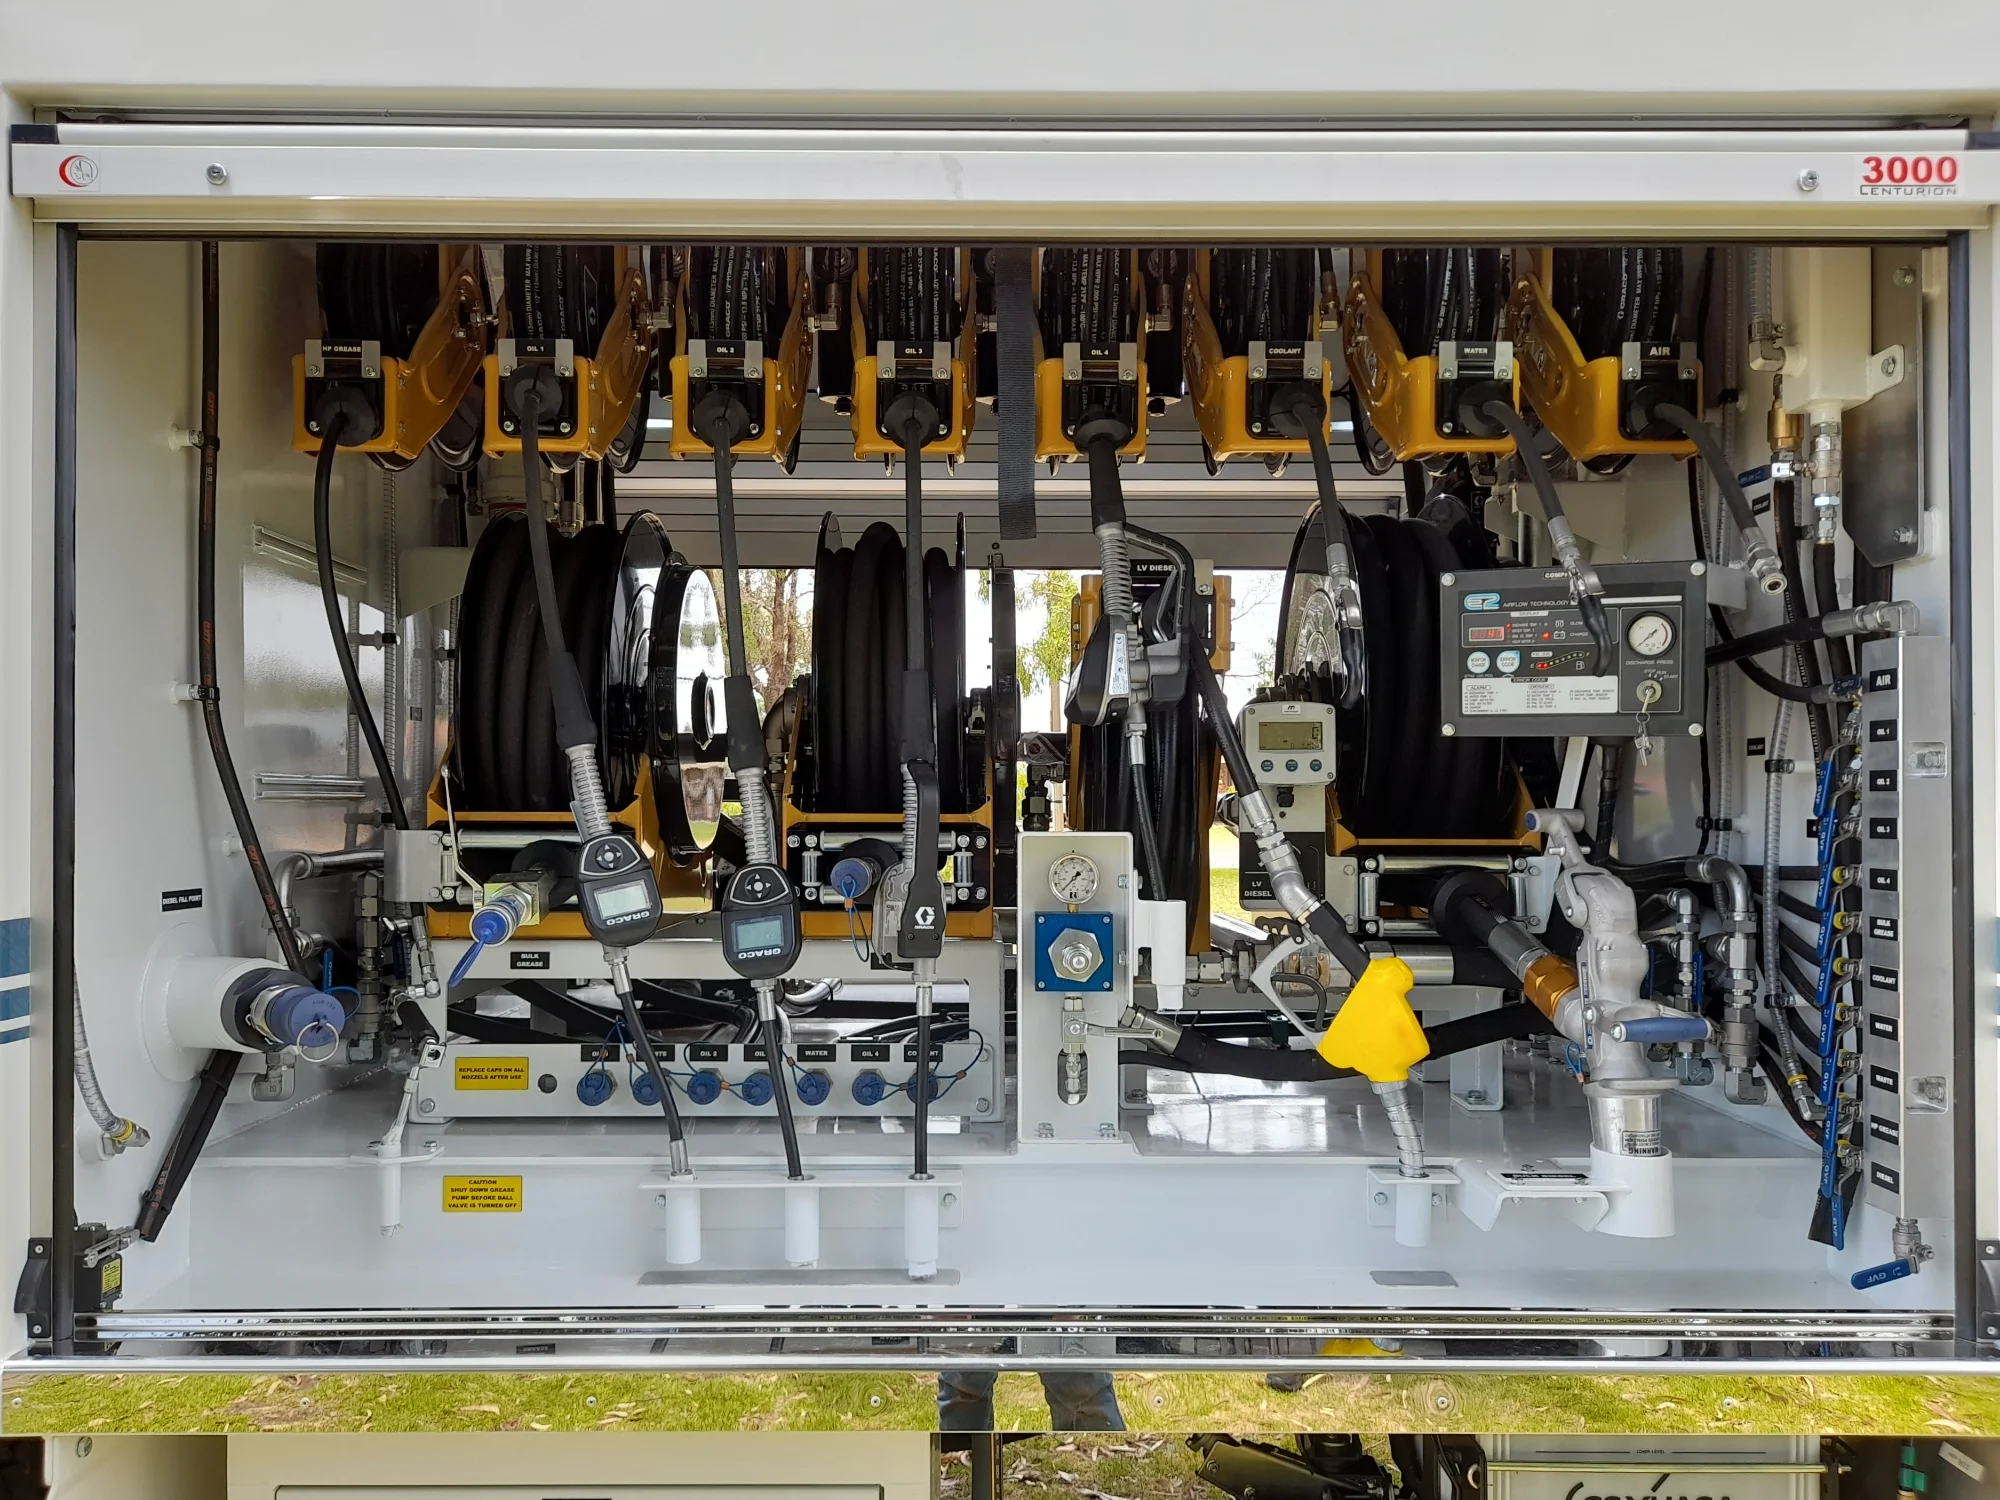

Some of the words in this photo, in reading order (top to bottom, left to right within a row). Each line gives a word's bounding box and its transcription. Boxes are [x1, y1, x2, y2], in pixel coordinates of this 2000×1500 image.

[1863, 156, 1957, 184] 3000
[1860, 185, 1957, 196] CENTURION
[1649, 346, 1671, 356] AIR
[1875, 675, 1891, 687] AIR
[1251, 880, 1262, 888] LV
[606, 911, 650, 926] GRACO
[1873, 928, 1894, 938] GREASE
[738, 948, 782, 960] GRACO
[1872, 974, 1897, 986] COOLANT
[1874, 1021, 1893, 1032] WATER
[1875, 1073, 1894, 1086] WASTE
[1875, 1170, 1895, 1185] DIESEL
[1866, 1272, 1887, 1284] GVF
